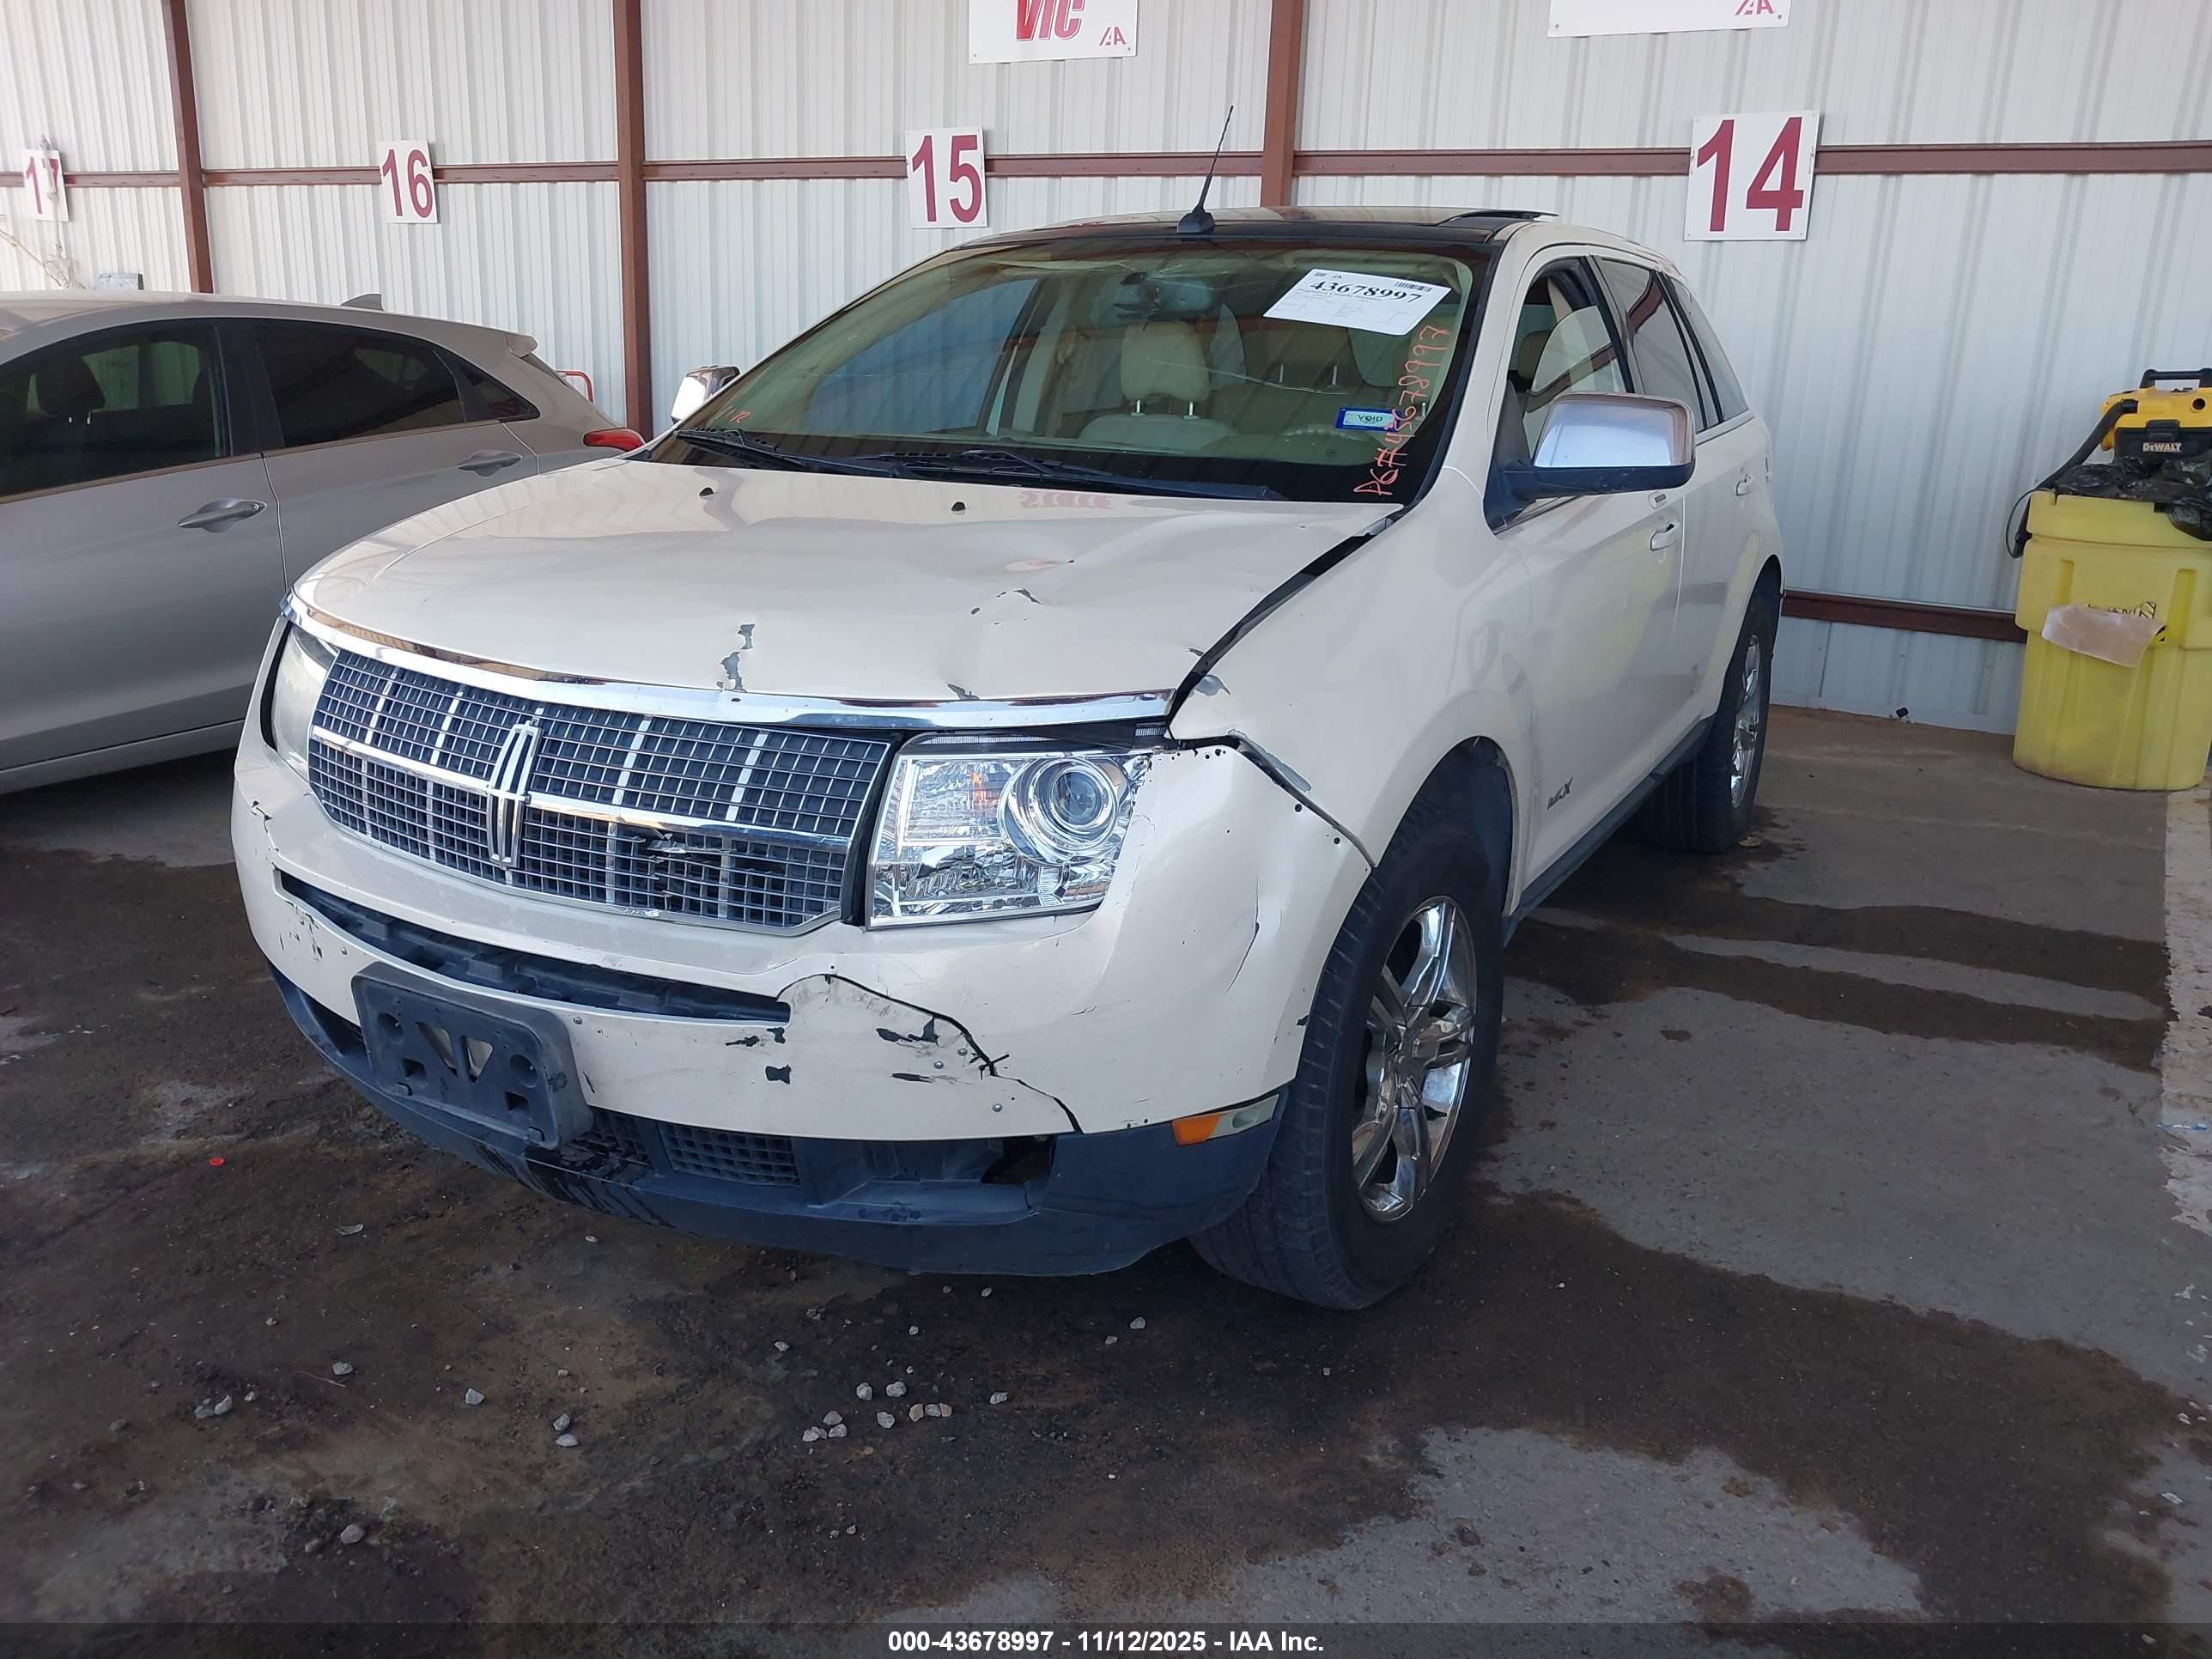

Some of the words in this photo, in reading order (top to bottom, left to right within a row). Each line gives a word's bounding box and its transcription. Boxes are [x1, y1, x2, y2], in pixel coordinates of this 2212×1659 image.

[381, 149, 434, 218] 16
[912, 134, 982, 223] 15
[1696, 116, 1805, 232] 14
[1310, 280, 1423, 303] 43678997
[1357, 414, 1383, 422] VOID
